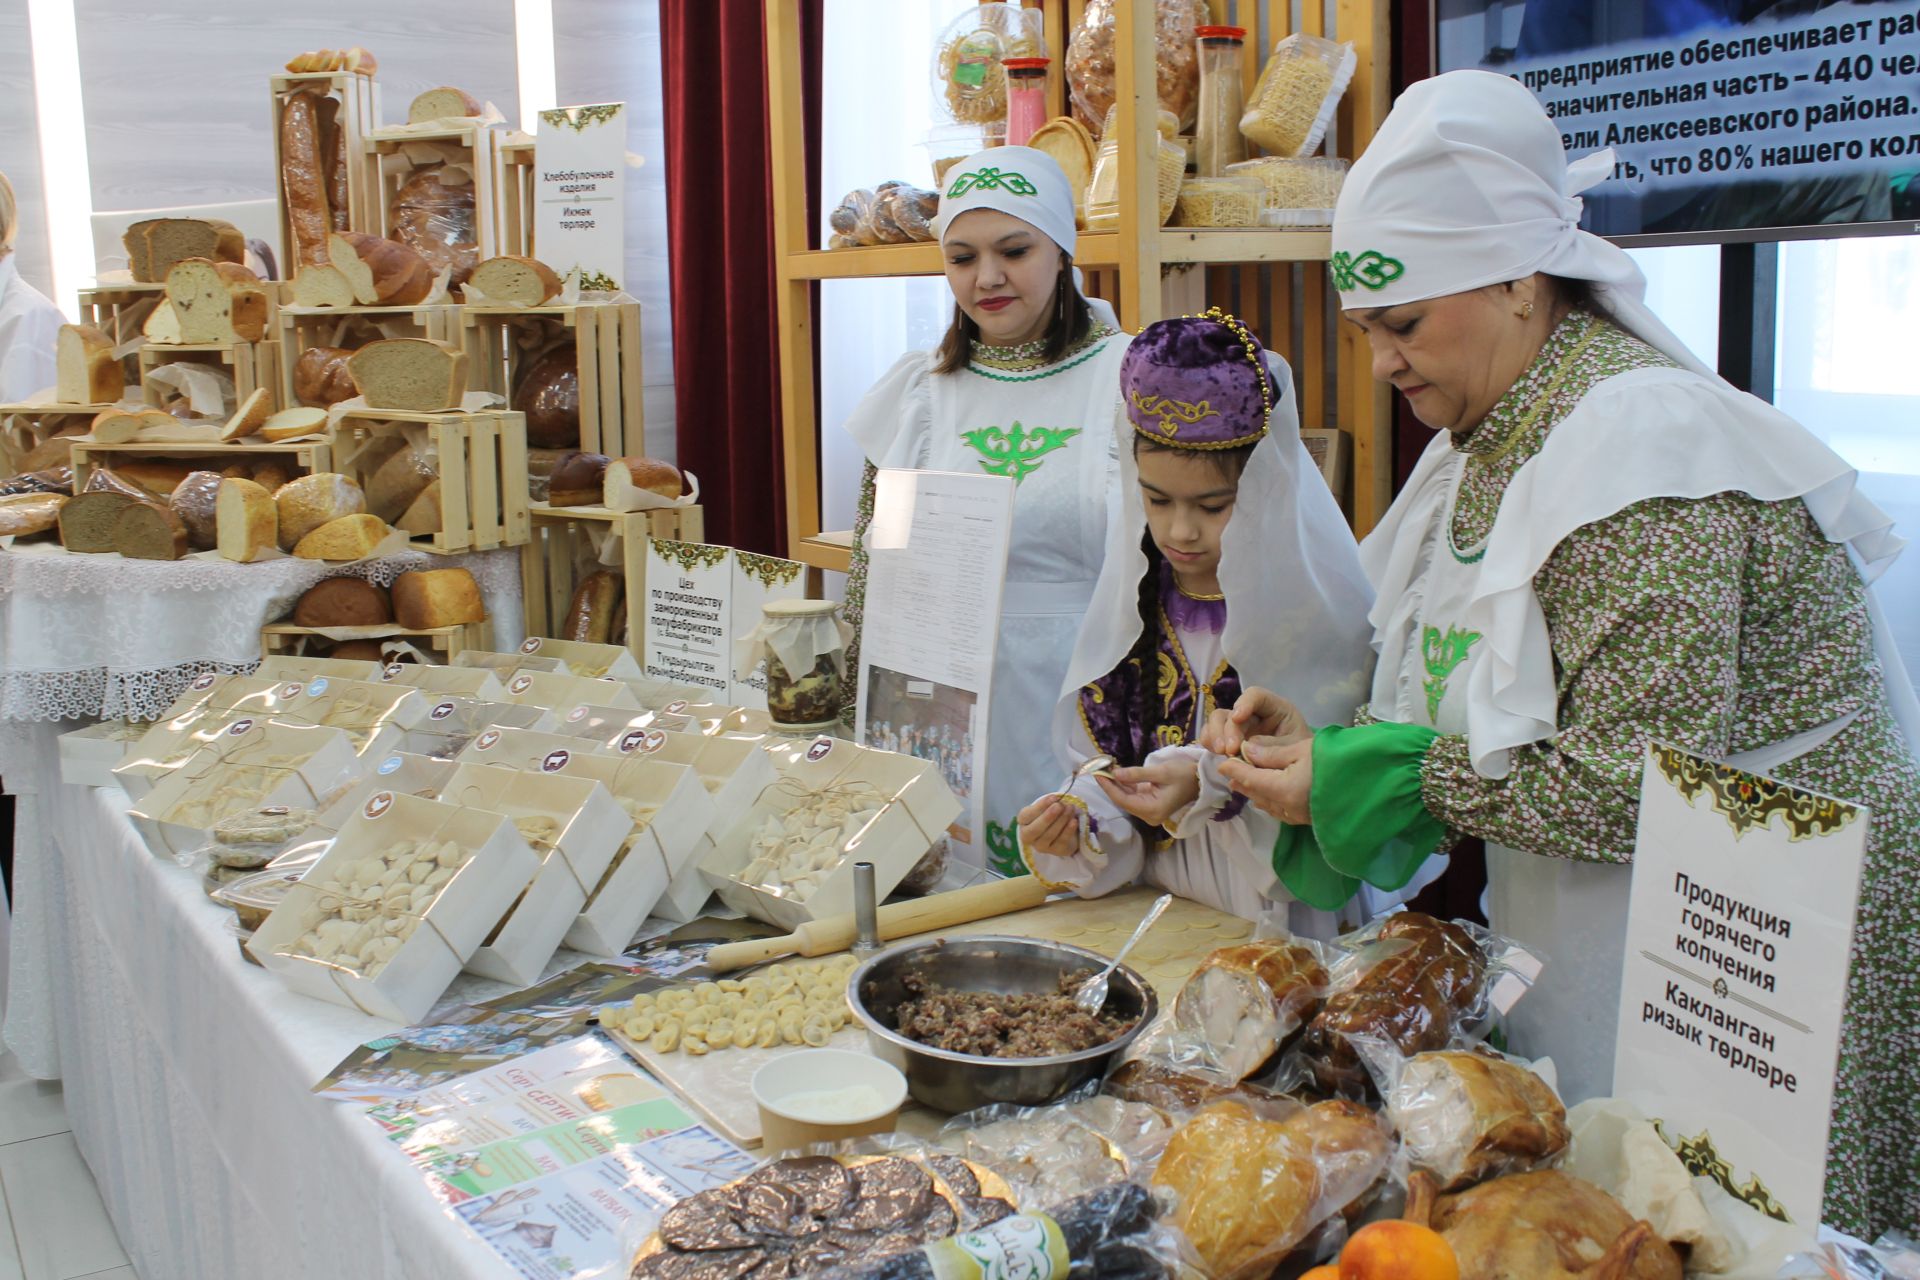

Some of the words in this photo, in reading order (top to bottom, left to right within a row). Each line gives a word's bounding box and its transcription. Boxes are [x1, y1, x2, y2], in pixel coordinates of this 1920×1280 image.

[1524, 50, 1674, 92] предприятие
[1680, 19, 1873, 66] обеспечивает
[1879, 9, 1920, 45] ра
[1545, 80, 1707, 118] значительная
[1713, 72, 1789, 97] часть
[1814, 54, 1874, 85] 440
[1604, 108, 1799, 146] Алексеевского
[1805, 95, 1918, 132] района.
[544, 171, 614, 182] Хлебобулочные
[1608, 161, 1644, 182] ть,
[1651, 156, 1692, 176] что
[1698, 144, 1754, 172] 80%
[1761, 139, 1863, 167] нашего
[559, 184, 596, 194] изделия
[563, 207, 592, 216] Икмәк
[652, 589, 662, 599] по
[664, 591, 723, 610] производству
[679, 577, 695, 590] Цех
[651, 616, 722, 637] полуфабрикатов
[654, 603, 719, 621] замороженных
[647, 665, 727, 691] ярымфабрикатлар
[657, 651, 715, 673] Тундырылган
[1674, 871, 1792, 939] Продукция
[1682, 908, 1776, 962] горячего
[1676, 934, 1776, 993] копчения
[1665, 980, 1775, 1052] Какланган
[1642, 1001, 1703, 1047] ризык
[1708, 1034, 1797, 1094] төрләре
